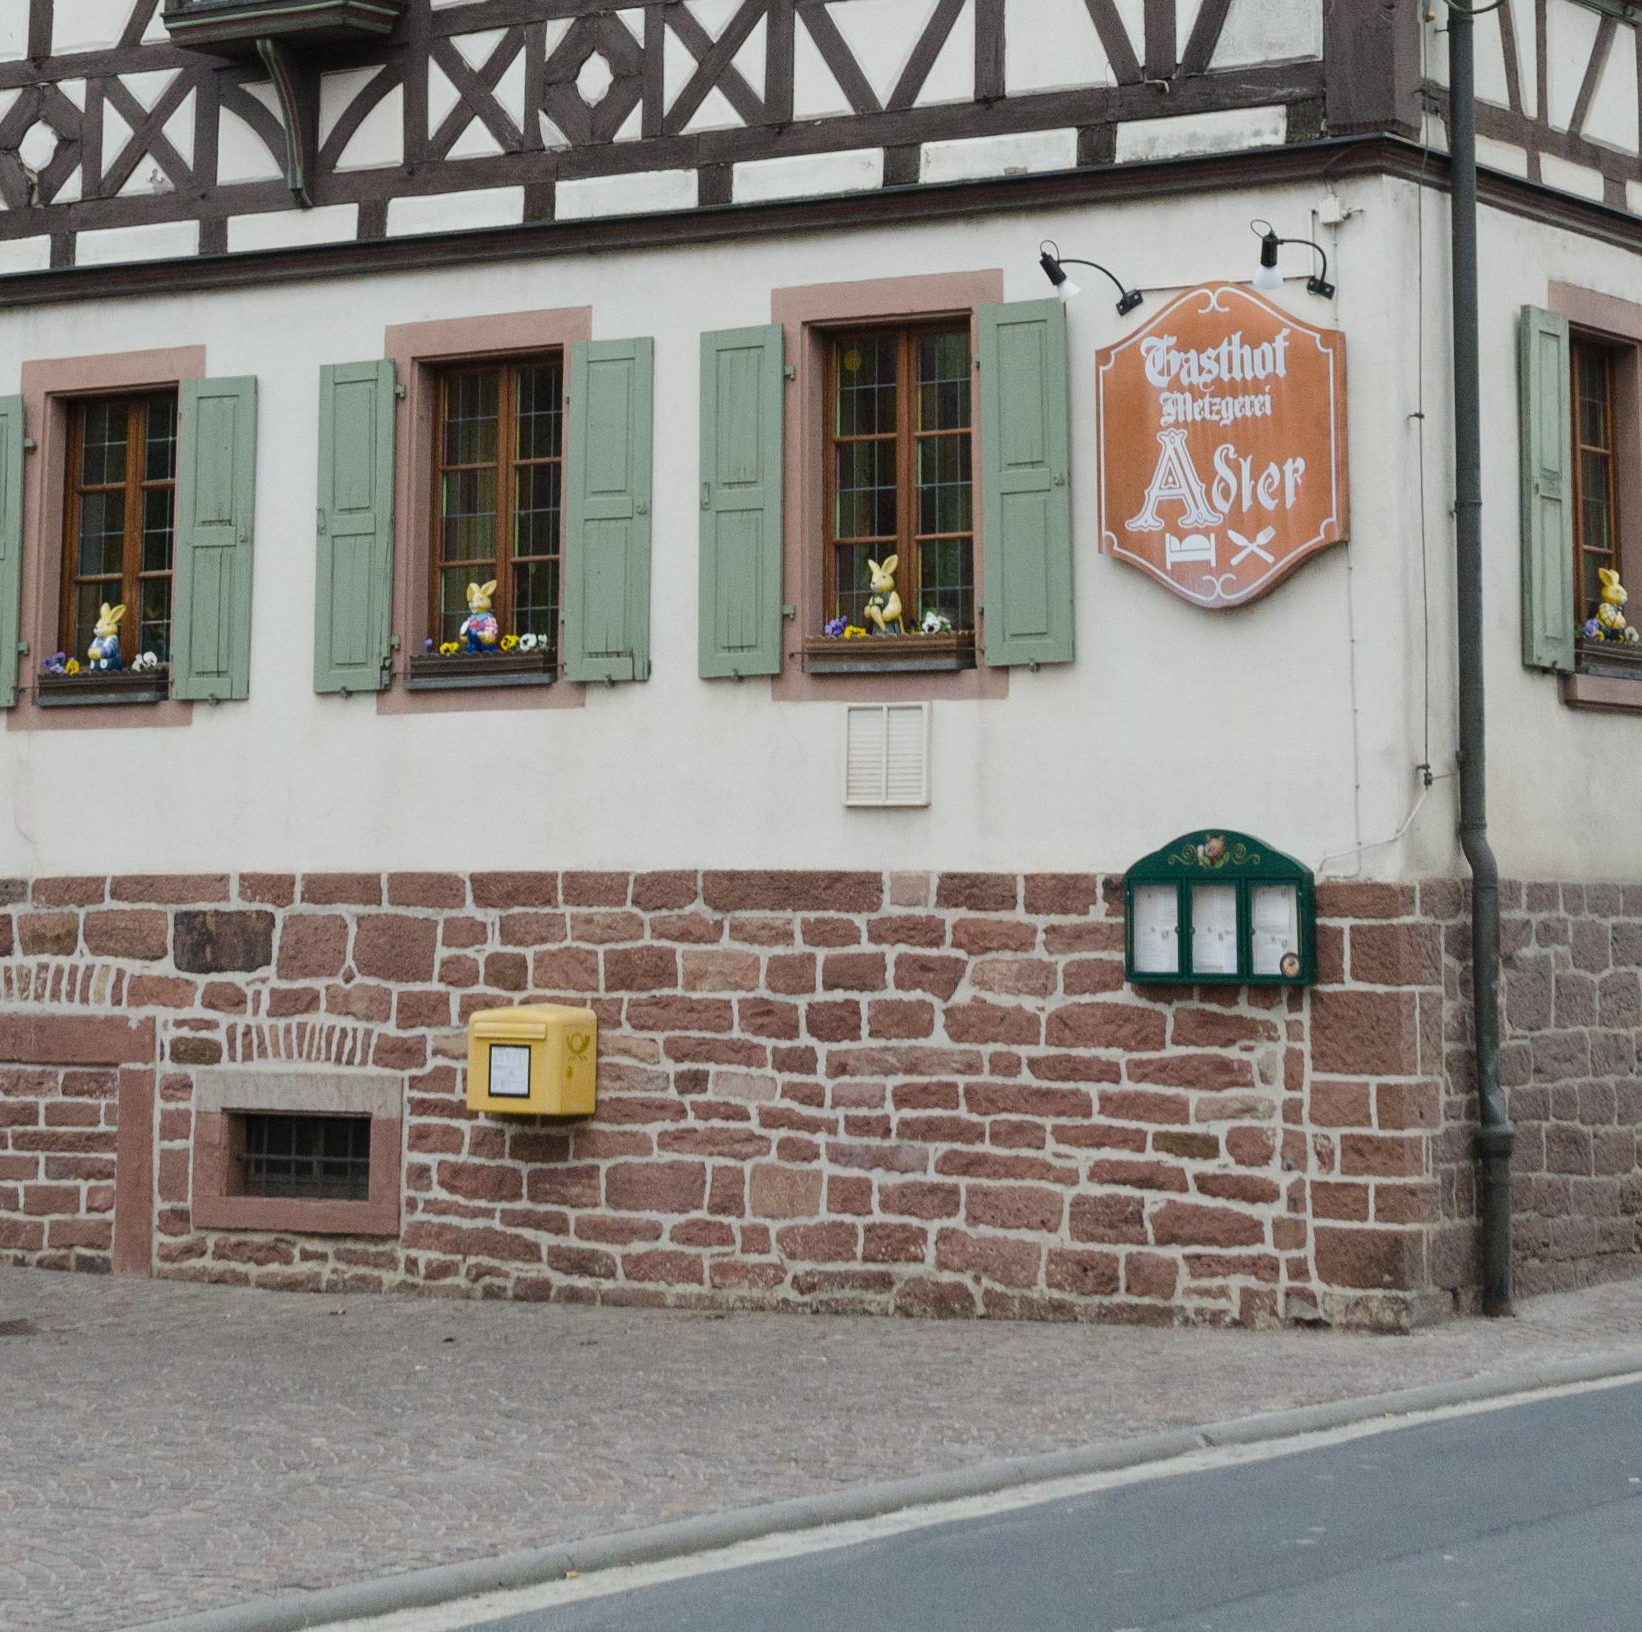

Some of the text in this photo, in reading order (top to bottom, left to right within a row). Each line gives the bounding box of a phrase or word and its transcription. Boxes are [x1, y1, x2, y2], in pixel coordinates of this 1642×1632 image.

[1141, 328, 1290, 391] Gasthof
[1159, 384, 1272, 426] Metzgerei
[1125, 428, 1306, 532] Adler
